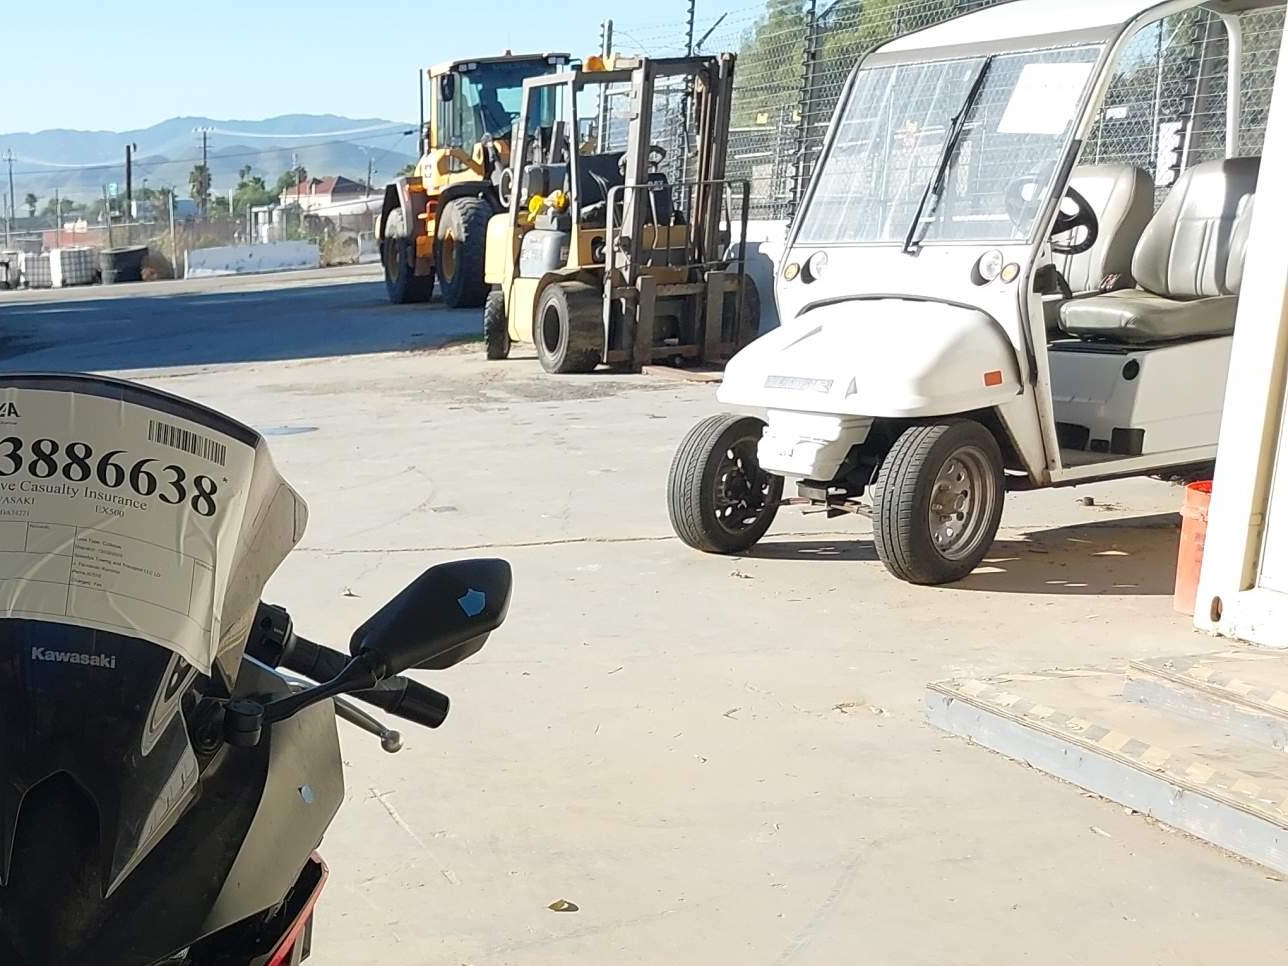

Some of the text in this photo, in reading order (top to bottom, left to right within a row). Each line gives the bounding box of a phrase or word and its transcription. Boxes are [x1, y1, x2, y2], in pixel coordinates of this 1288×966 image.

[19, 480, 80, 499] Casualty
[84, 486, 148, 511] Insurance
[31, 646, 116, 669] Kawasaki
